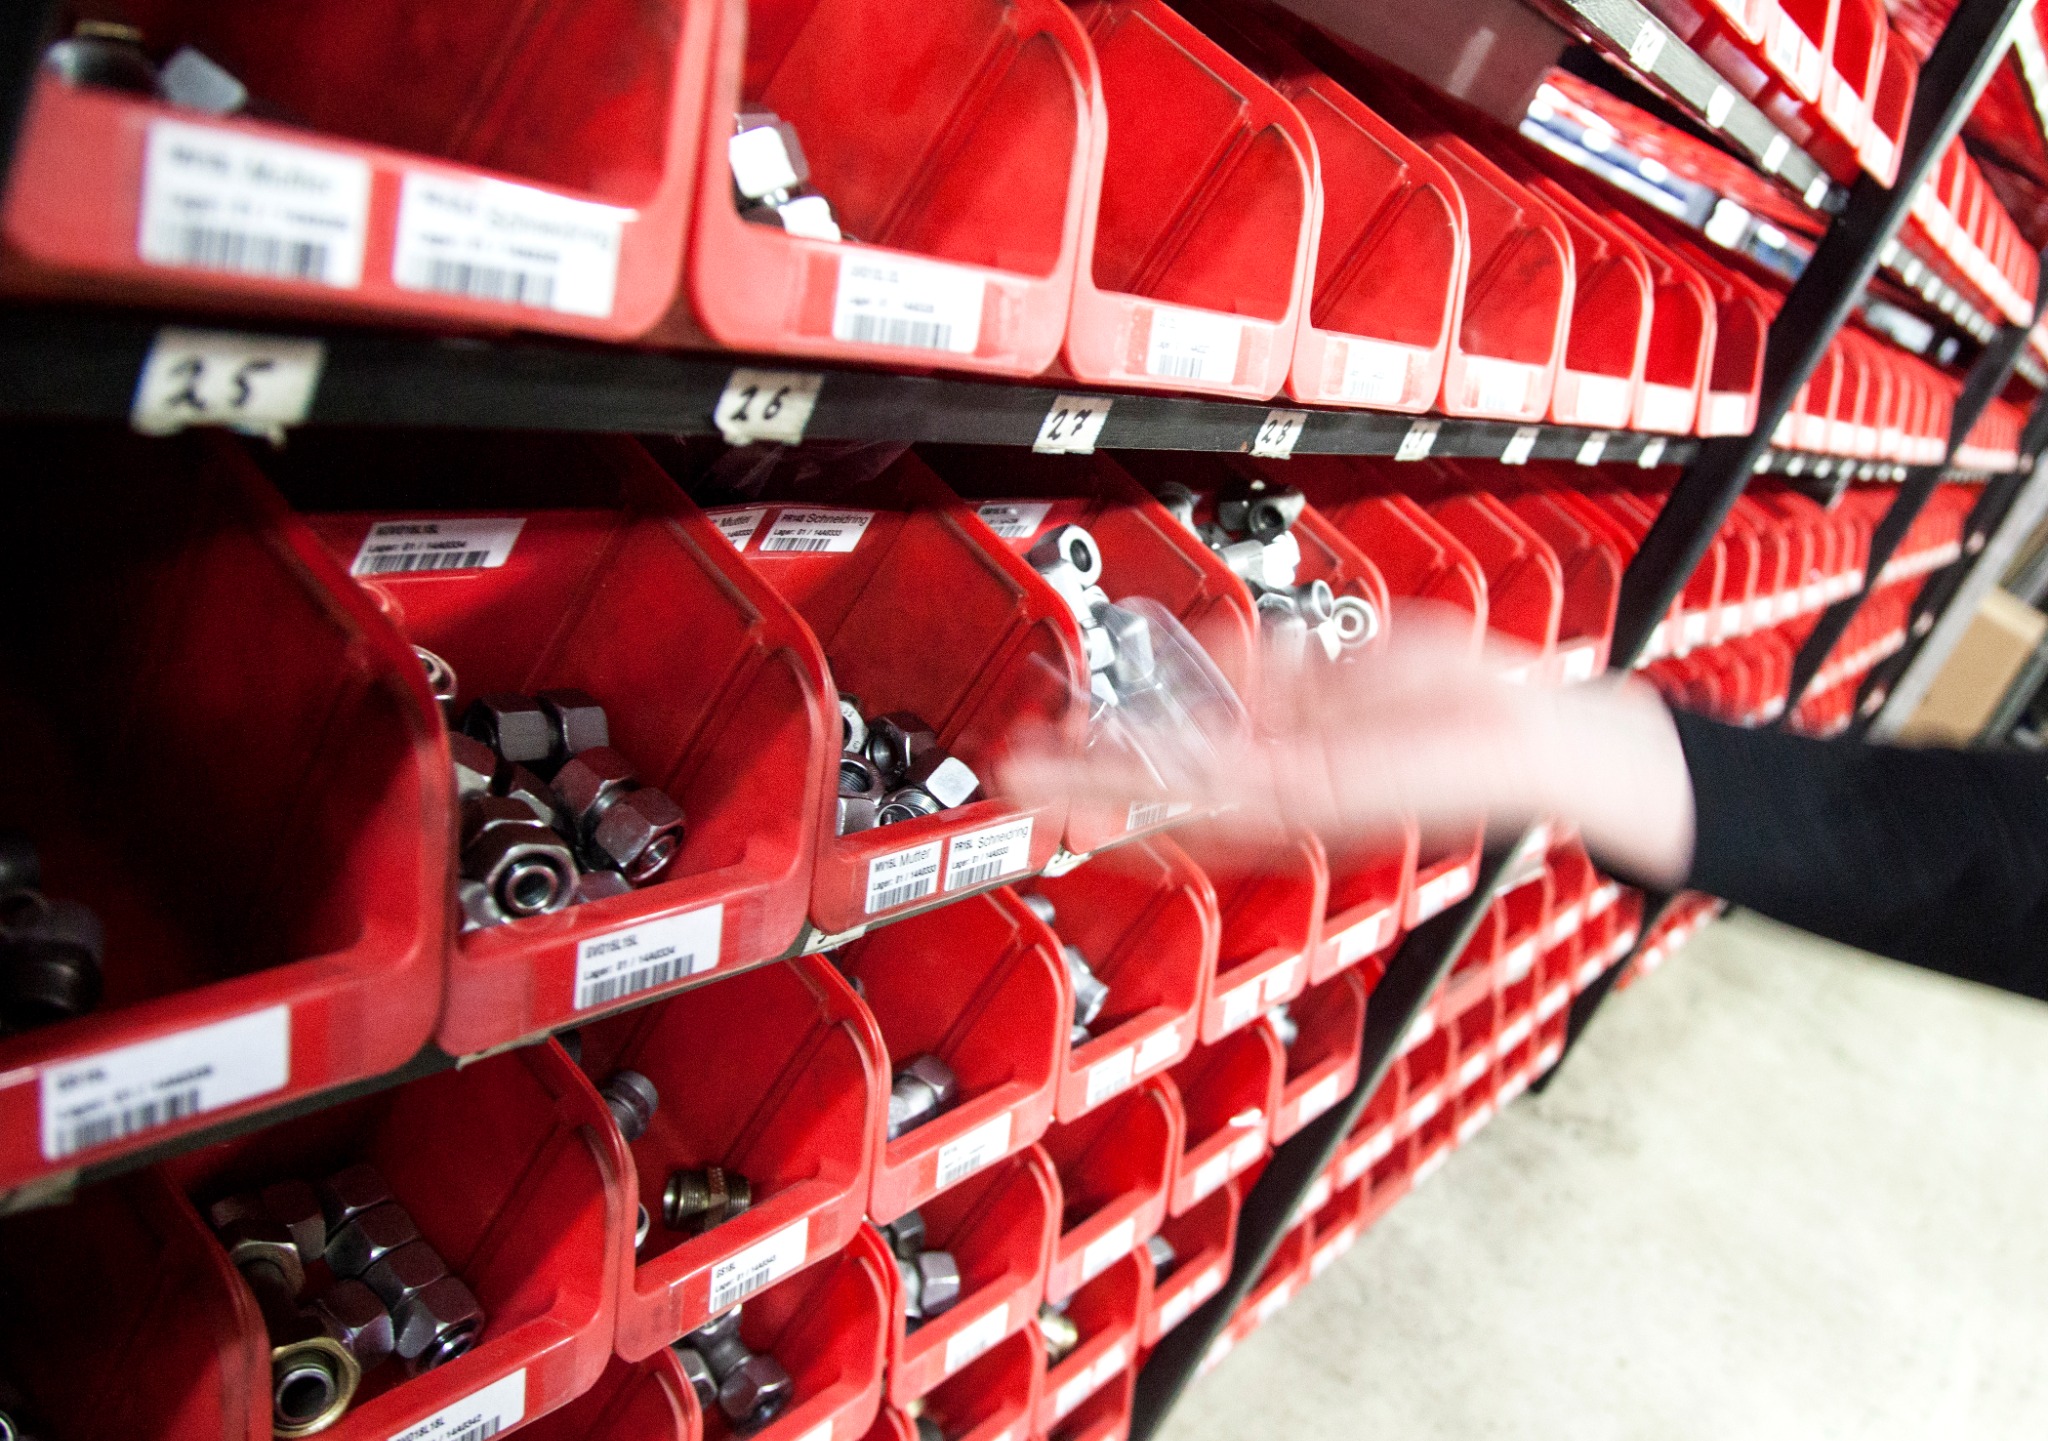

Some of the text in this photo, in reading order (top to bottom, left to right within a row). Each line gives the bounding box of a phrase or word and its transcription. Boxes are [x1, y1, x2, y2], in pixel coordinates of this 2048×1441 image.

[163, 357, 275, 411] 25
[730, 385, 790, 421] 26
[1047, 408, 1093, 440] 27
[1261, 420, 1293, 445] 28
[720, 515, 752, 527] Mutter
[806, 513, 869, 526] Schneidring
[773, 528, 795, 536] Lager:
[978, 826, 1029, 849] Schneidring
[900, 848, 932, 867] Mutter
[952, 858, 971, 869] Lager:
[873, 878, 893, 891] Lager:
